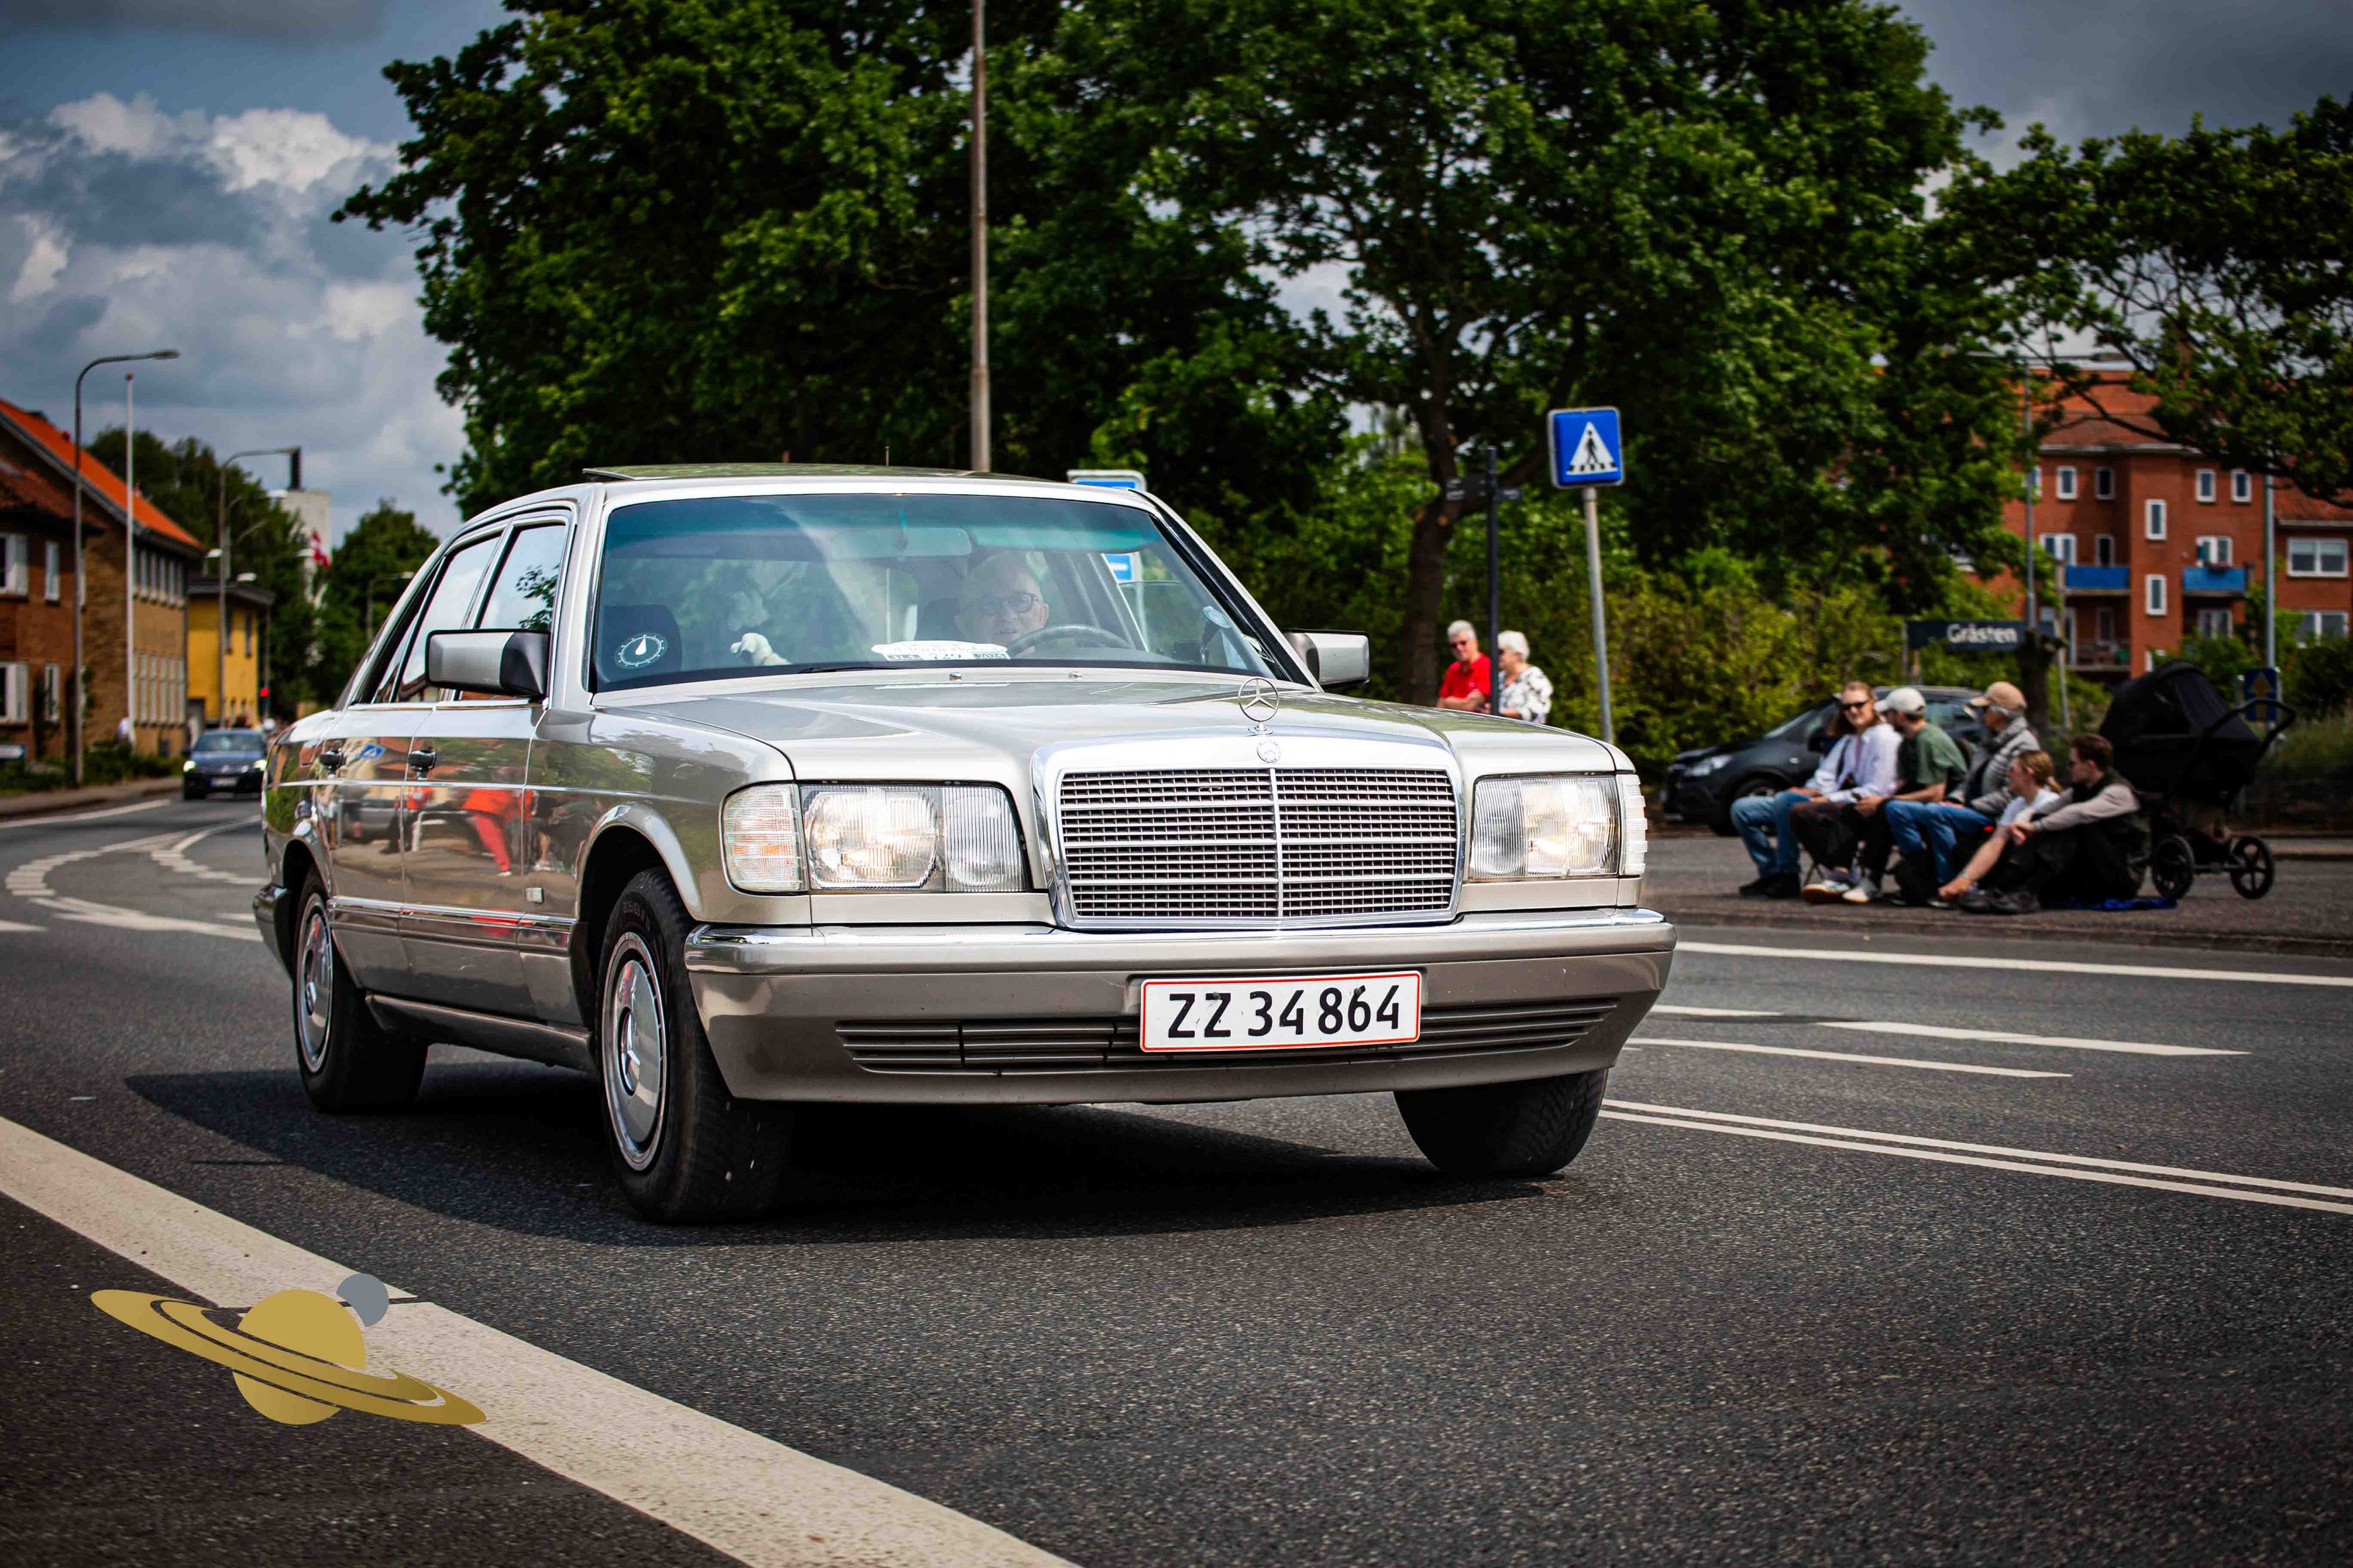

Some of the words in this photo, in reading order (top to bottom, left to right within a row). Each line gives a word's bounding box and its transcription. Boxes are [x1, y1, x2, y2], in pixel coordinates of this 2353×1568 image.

[1168, 992, 1232, 1039] ZZ
[1248, 989, 1304, 1037] 34
[1318, 984, 1400, 1035] 864
